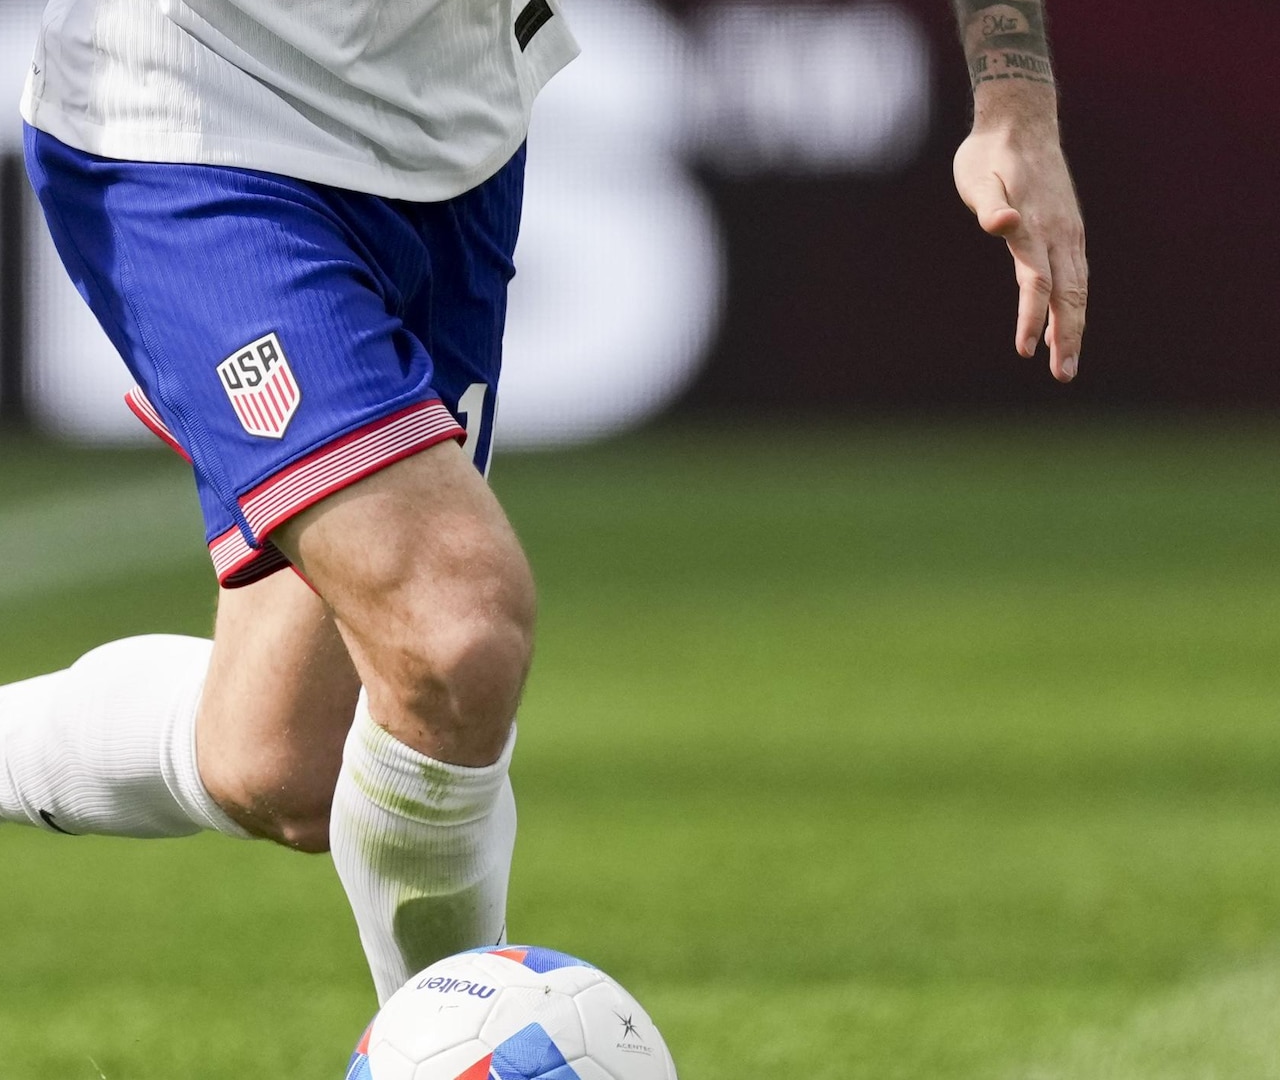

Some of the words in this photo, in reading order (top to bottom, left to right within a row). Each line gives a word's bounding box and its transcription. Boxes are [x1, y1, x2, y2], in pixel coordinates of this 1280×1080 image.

[222, 340, 278, 389] USA
[457, 383, 499, 480] 1
[416, 977, 496, 999] molten
